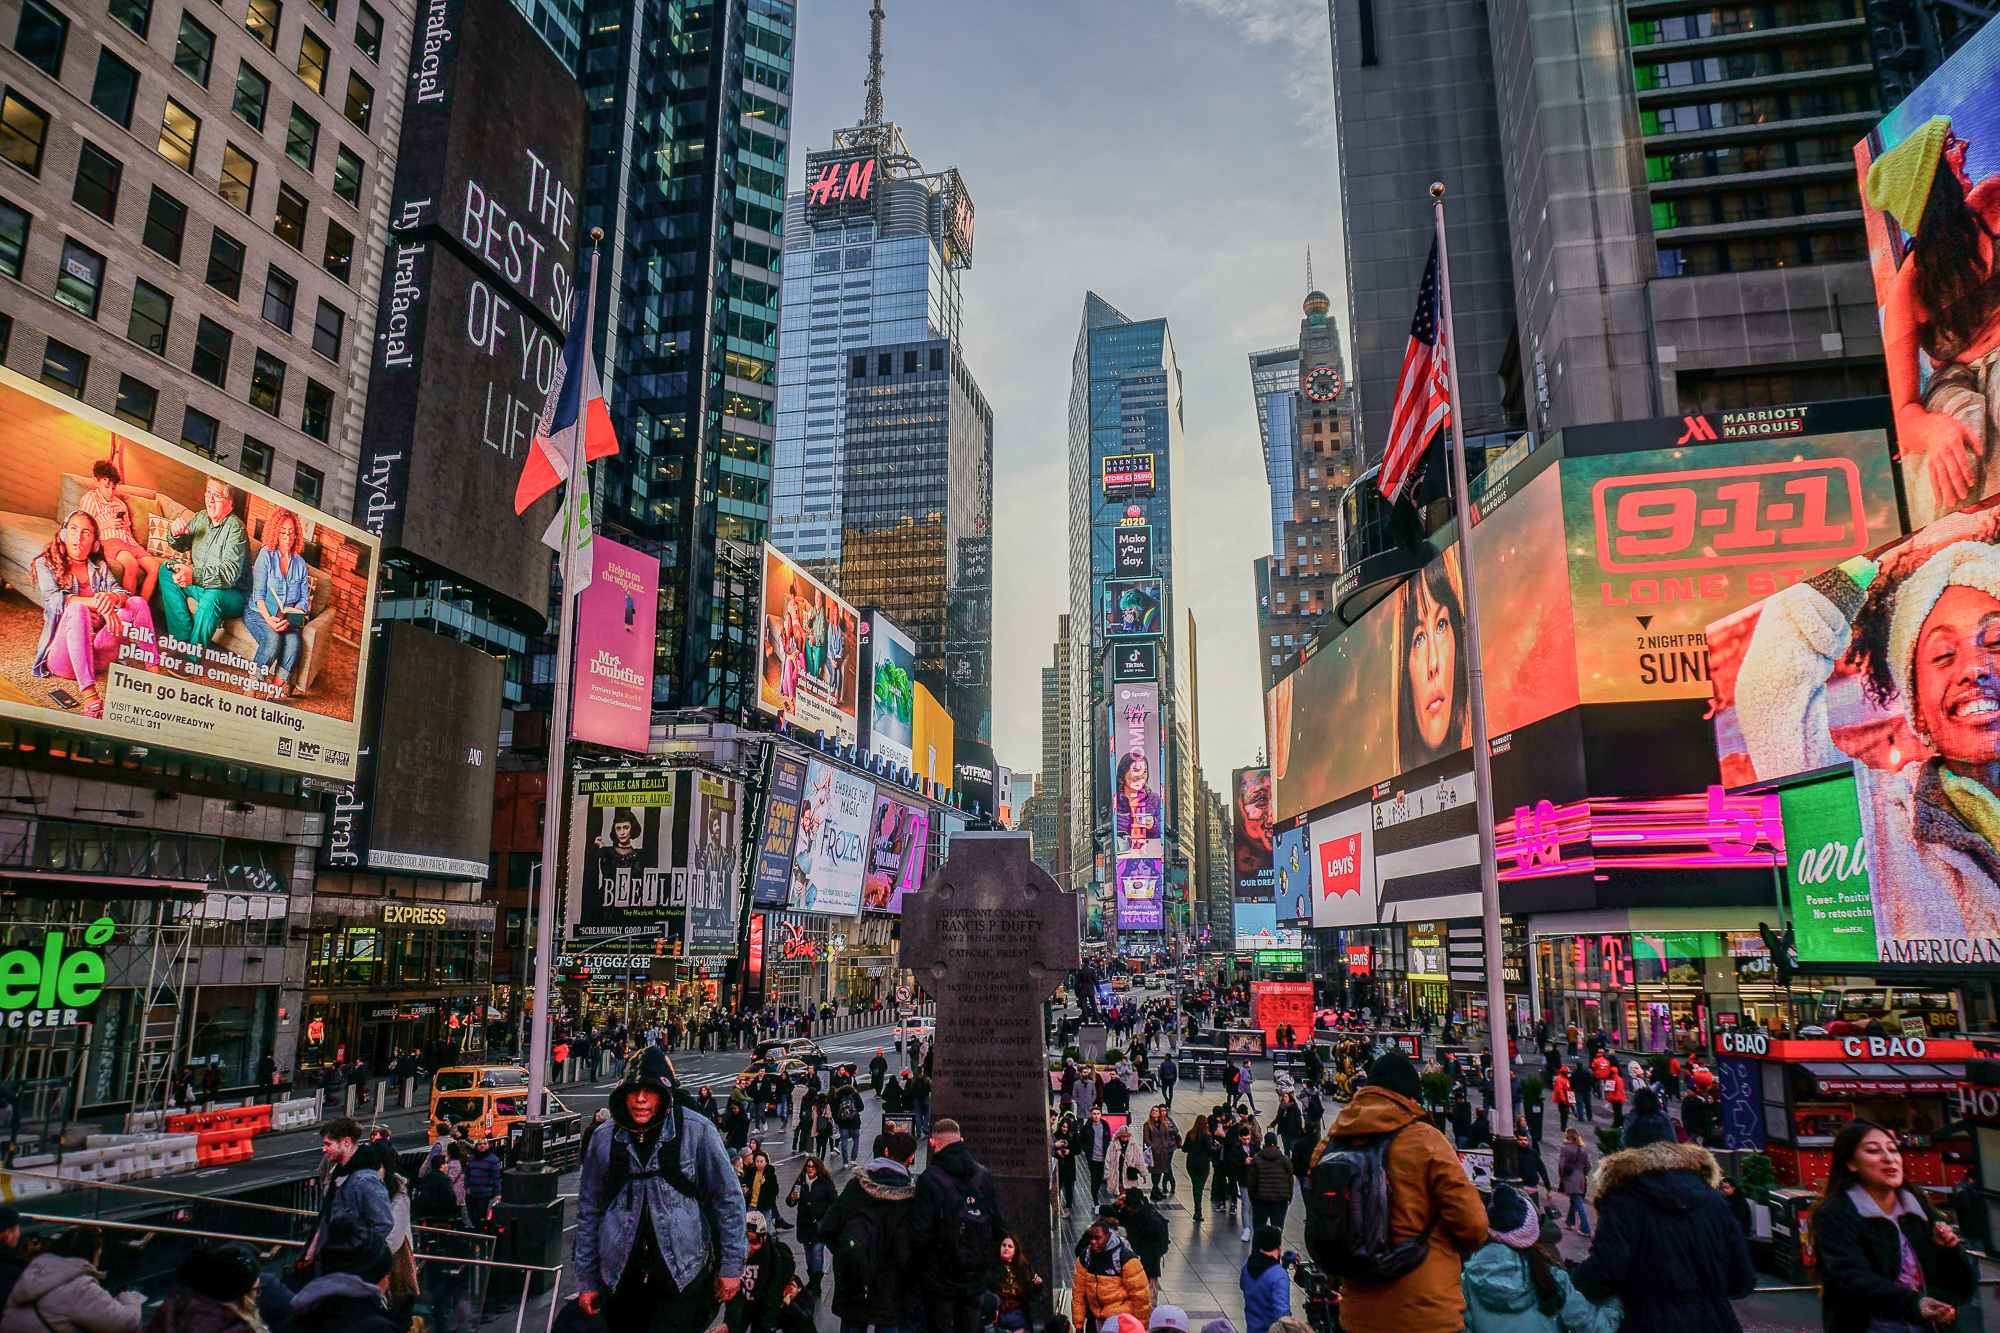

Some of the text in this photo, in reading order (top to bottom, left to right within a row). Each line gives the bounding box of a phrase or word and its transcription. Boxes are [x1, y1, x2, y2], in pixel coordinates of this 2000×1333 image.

[412, 0, 452, 103] rafacial
[810, 159, 875, 205] H&M
[526, 148, 575, 251] THE
[462, 179, 545, 298] BEST
[468, 281, 510, 356] OF
[1722, 407, 1808, 424] MARRIOTT
[1724, 421, 1800, 437] MARQUIS
[1481, 476, 1510, 505] MARRIOTT
[1482, 490, 1507, 517] MARQUIS
[1120, 517, 1146, 527] 2020
[1119, 534, 1146, 543] Make
[1121, 545, 1145, 556] your
[1123, 557, 1143, 567] day.
[608, 562, 640, 582] Help is on
[1336, 565, 1361, 588] MARRIOTT
[602, 571, 614, 583] the
[629, 581, 645, 593] dear.
[1337, 578, 1358, 597] MARQUIS
[1601, 567, 1828, 606] LONE ST
[121, 621, 269, 676] Talk about making a
[1638, 635, 1685, 649] 2 NIGHT
[598, 650, 622, 665] Mrs.
[119, 643, 285, 698] plan for an emergency.
[590, 659, 645, 686] Doubtfire
[114, 670, 305, 731] Then go back to not talking.
[591, 684, 611, 695] Previews
[611, 689, 624, 699] begin
[1131, 691, 1151, 699] Spotify
[111, 701, 215, 731] VISIT NYC.GOV/READYNY
[1124, 703, 1145, 715] Light
[110, 712, 161, 730] OR CALL 311
[279, 739, 320, 755] ad NYC
[326, 748, 349, 761] READY
[880, 744, 909, 766] LG SIGNATURE
[467, 748, 483, 767] AND
[581, 778, 667, 792] TIMES SQUARE CAN REALLY
[876, 754, 963, 809] BROADWAY
[595, 793, 671, 805] MAKE YOU FEEL ALIVE!
[835, 781, 868, 804] EMBRACE THE
[771, 800, 796, 822] COME
[841, 800, 859, 818] MAGIC
[765, 834, 792, 855] AWAY
[820, 819, 867, 866] FROZEN
[602, 872, 687, 907] BEETLE
[1241, 878, 1275, 887] OUR DREA
[1807, 891, 1870, 905] Power. Positiv
[384, 905, 447, 925] EXPRESS
[943, 908, 1035, 918] LIEUTENANT COLONEL
[1125, 914, 1158, 923] RARE
[1813, 905, 1872, 919] No retouchin
[624, 926, 639, 934] GOOD
[936, 920, 1044, 931] FRANCIS DUFFY
[941, 935, 957, 943] MAY
[949, 949, 1029, 957] CATHOLIC PRIEST
[1880, 938, 2000, 964] AMERICAN
[585, 957, 650, 969] LUGGAGE
[372, 1006, 435, 1017] EXPRESS EXPRESS
[1930, 1012, 1957, 1027] BIG
[959, 1018, 974, 1026] LIFE
[980, 1018, 989, 1026] OF
[995, 1018, 1029, 1026] SERVICE
[968, 1036, 986, 1045] AND
[991, 1036, 1032, 1045] COUNTRY
[1722, 1032, 1767, 1055] C BAO
[1844, 1036, 1926, 1057] C BAO
[1958, 1087, 2000, 1117] HO
